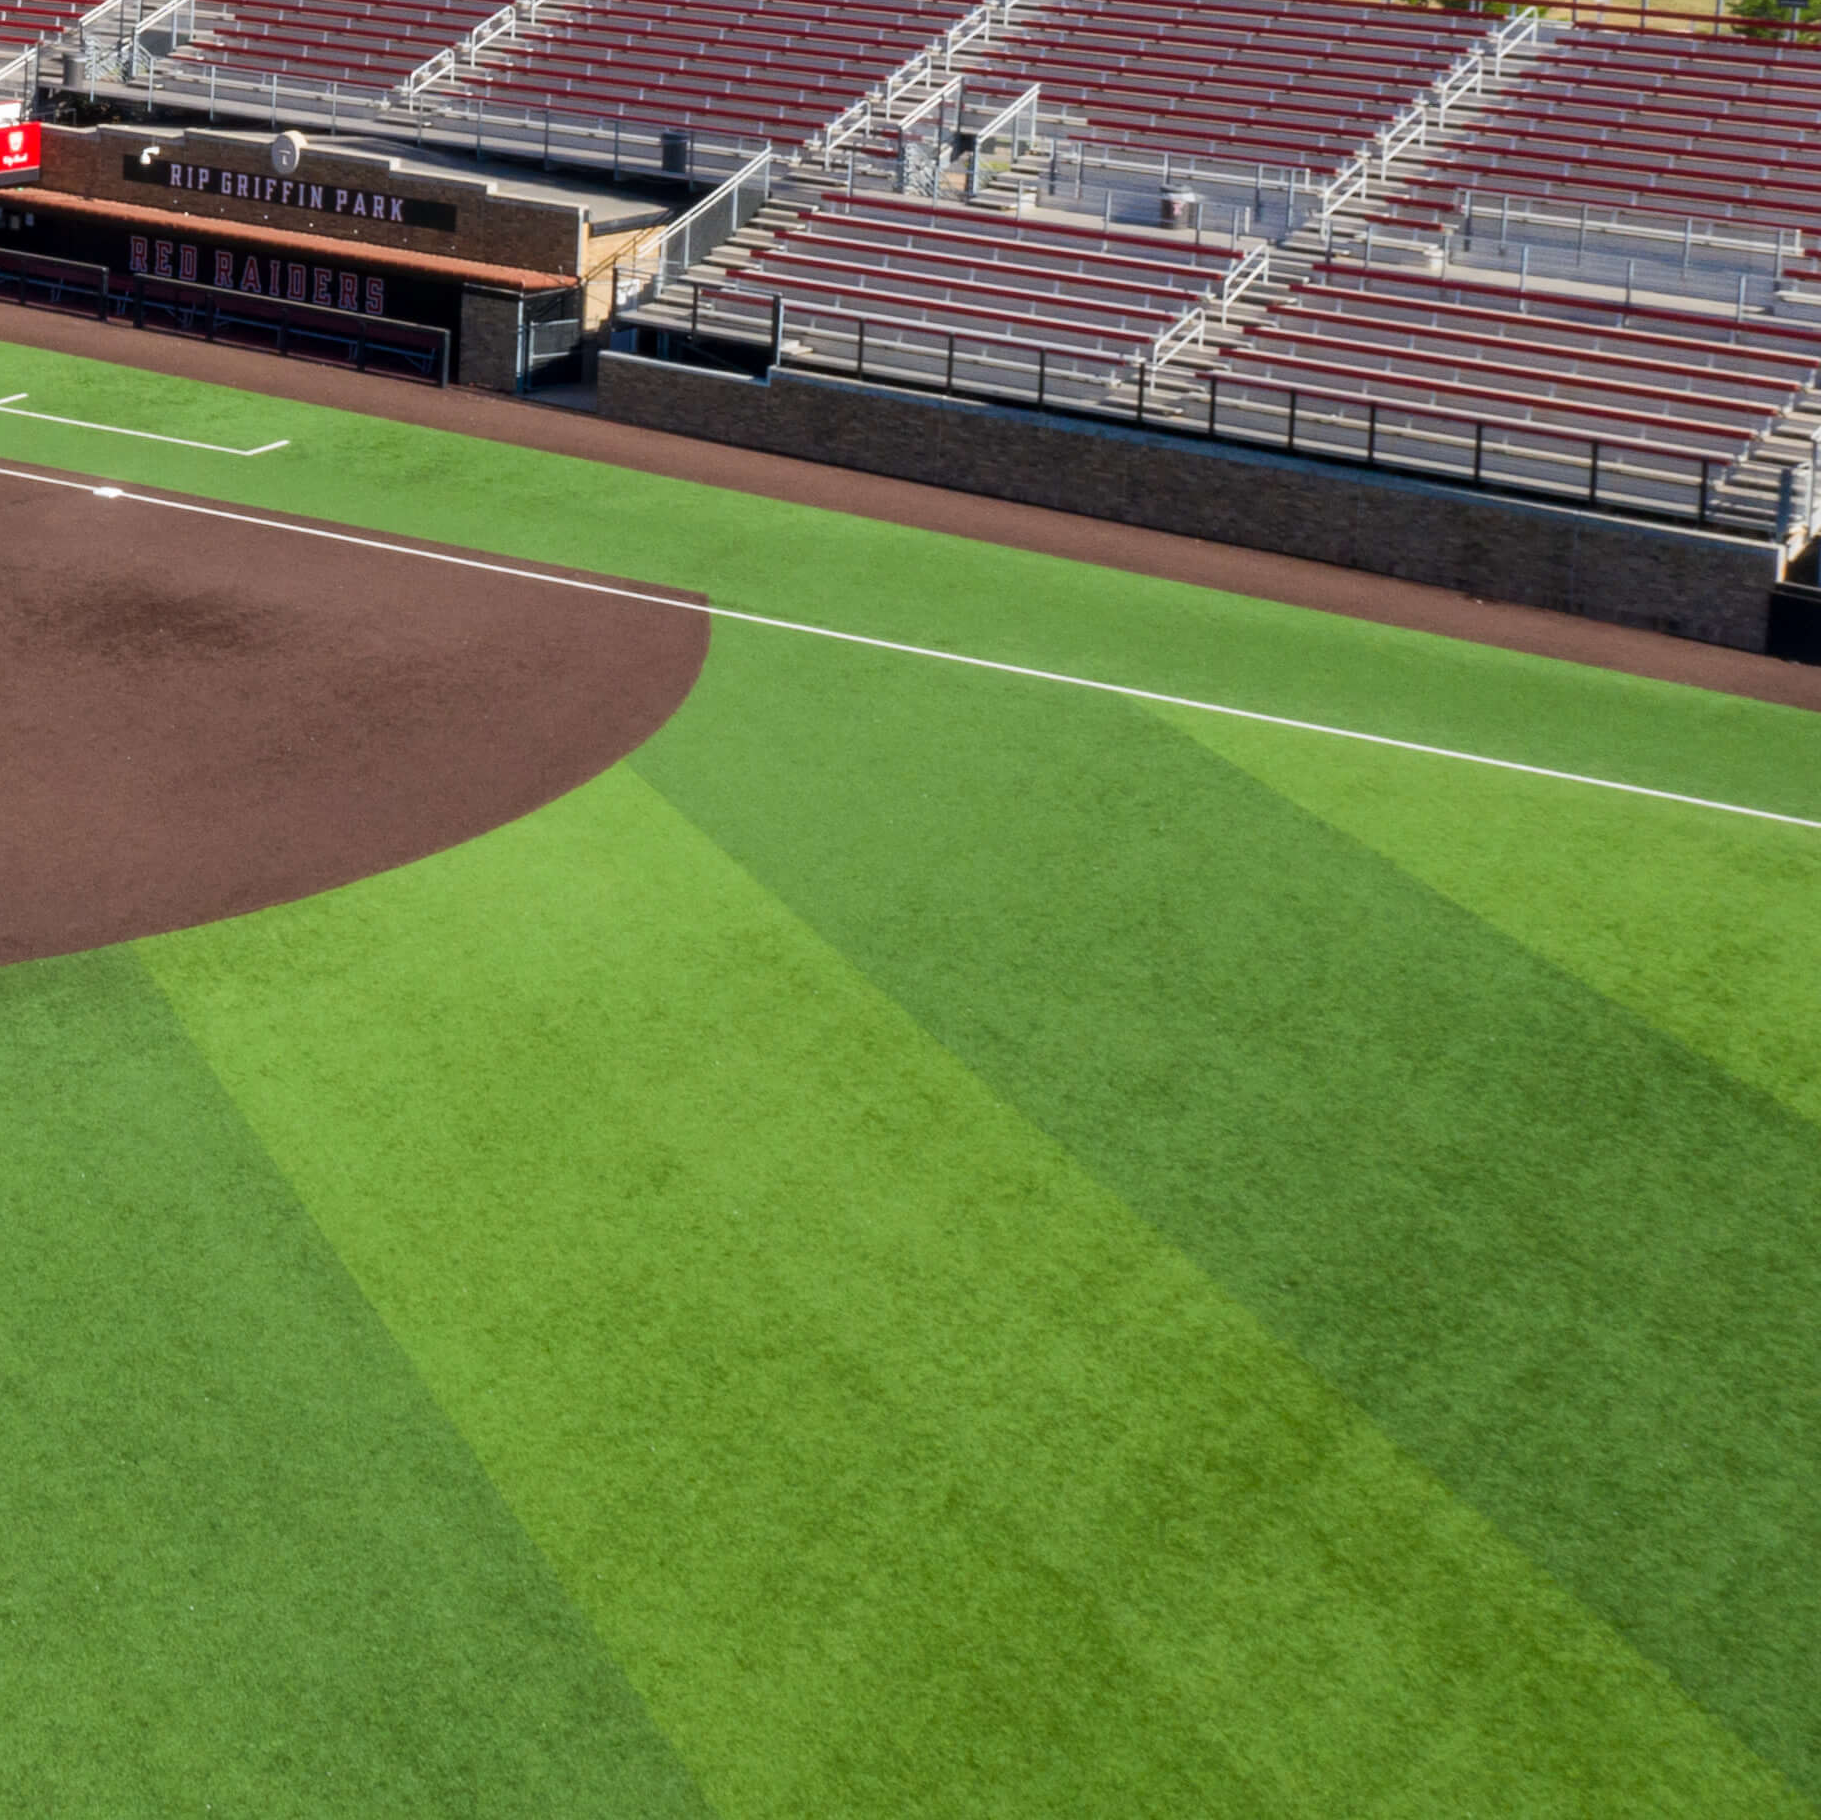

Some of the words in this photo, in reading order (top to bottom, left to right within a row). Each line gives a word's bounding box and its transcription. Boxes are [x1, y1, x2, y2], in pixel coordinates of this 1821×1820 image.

[169, 163, 210, 191] RIP
[220, 171, 324, 209] GRIFFIN
[335, 188, 404, 223] PARK
[129, 235, 198, 281] RED
[214, 249, 384, 316] RAIDERS
